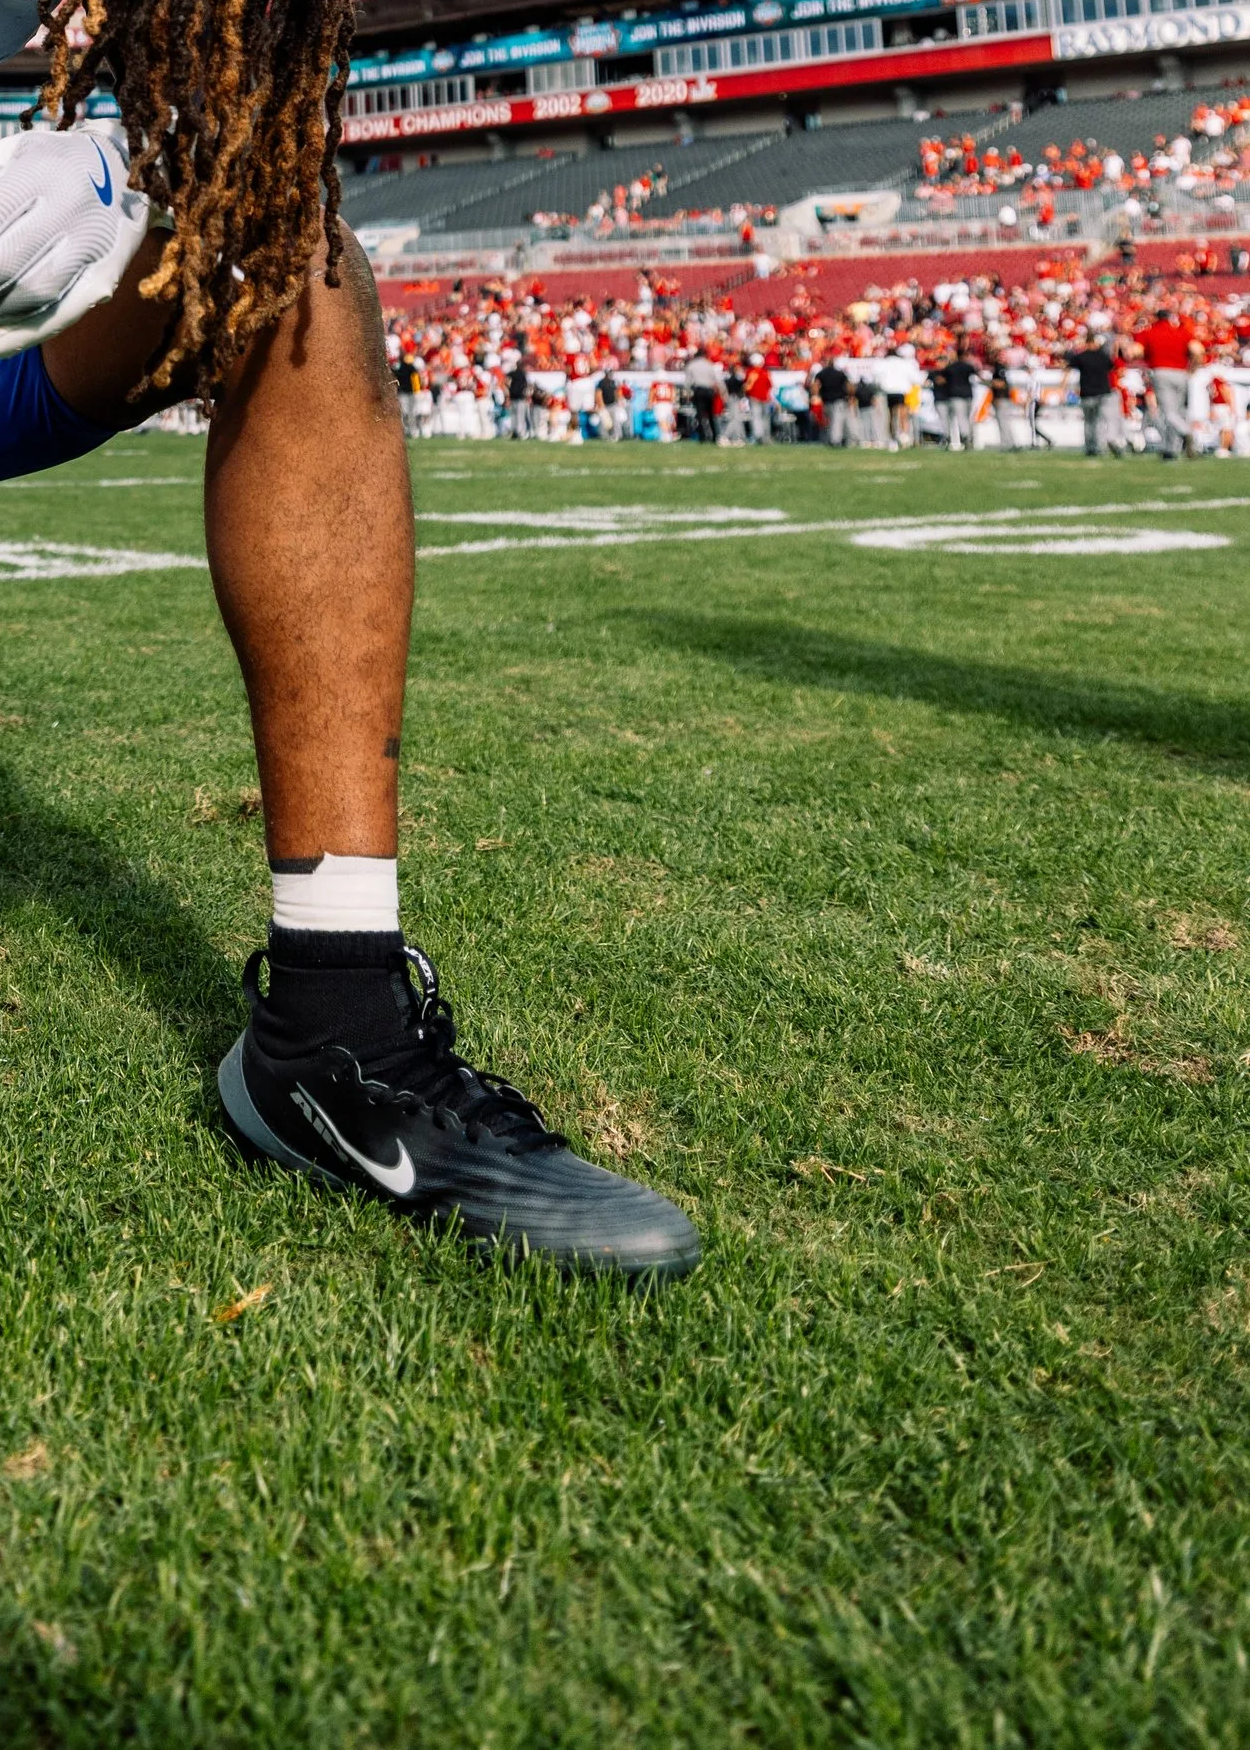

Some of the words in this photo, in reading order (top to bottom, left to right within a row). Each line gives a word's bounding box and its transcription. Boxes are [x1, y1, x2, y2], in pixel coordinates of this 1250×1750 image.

[791, 0, 825, 20] JOIN
[629, 23, 658, 43] JOIN
[659, 19, 685, 38] THE
[686, 10, 746, 34] INVASION
[1060, 10, 1241, 58] RAYMOND
[487, 45, 508, 63] THE
[532, 94, 582, 121] 2002
[635, 80, 688, 108] 2020
[349, 117, 400, 142] BOWL
[400, 102, 512, 136] CHAMPIONS
